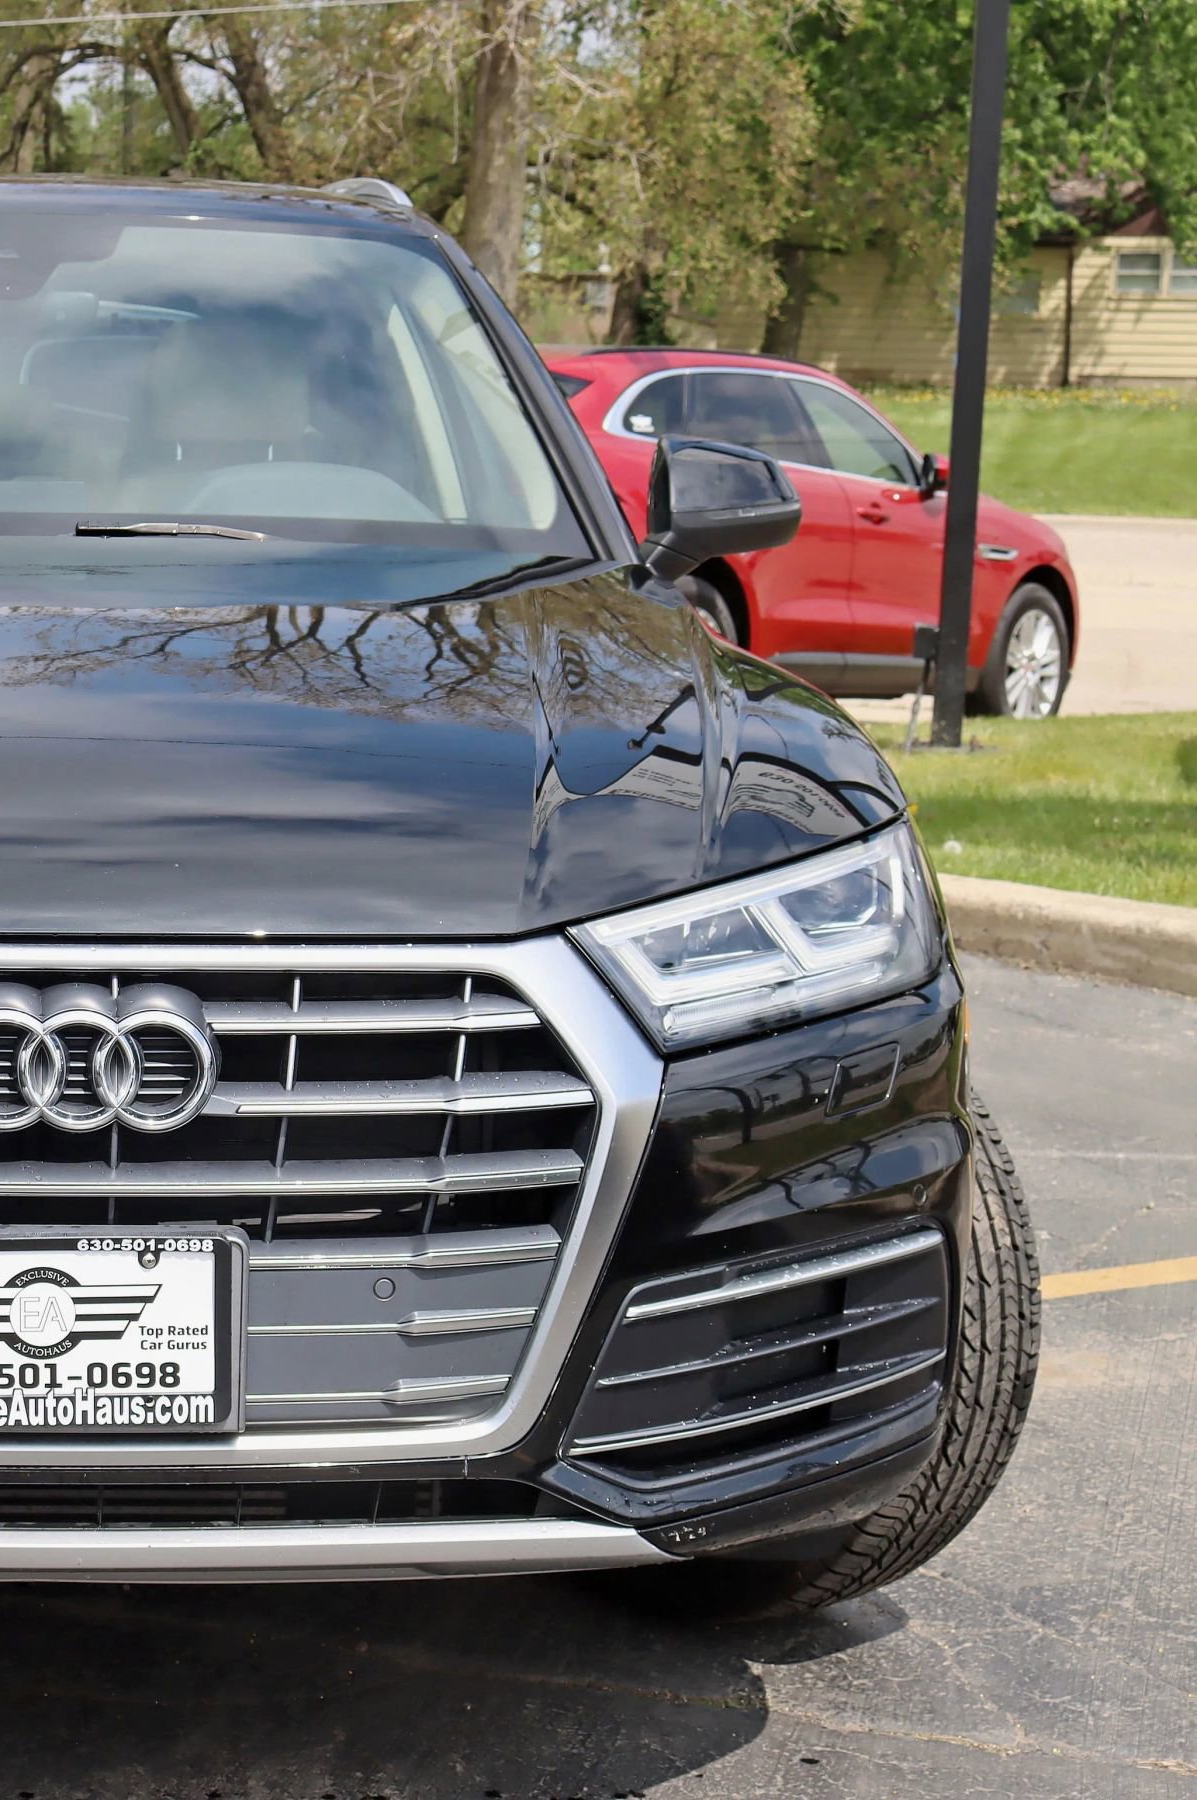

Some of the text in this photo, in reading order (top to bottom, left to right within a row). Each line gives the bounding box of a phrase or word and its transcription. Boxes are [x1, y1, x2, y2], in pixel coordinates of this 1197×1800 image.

[77, 1238, 214, 1252] 630-501-0698
[15, 1270, 70, 1287] EXCLUSIVE
[19, 1296, 68, 1332] EA
[138, 1324, 209, 1339] Top Rated
[14, 1340, 72, 1357] AUTOHAUS
[140, 1339, 207, 1351] Car Gurus
